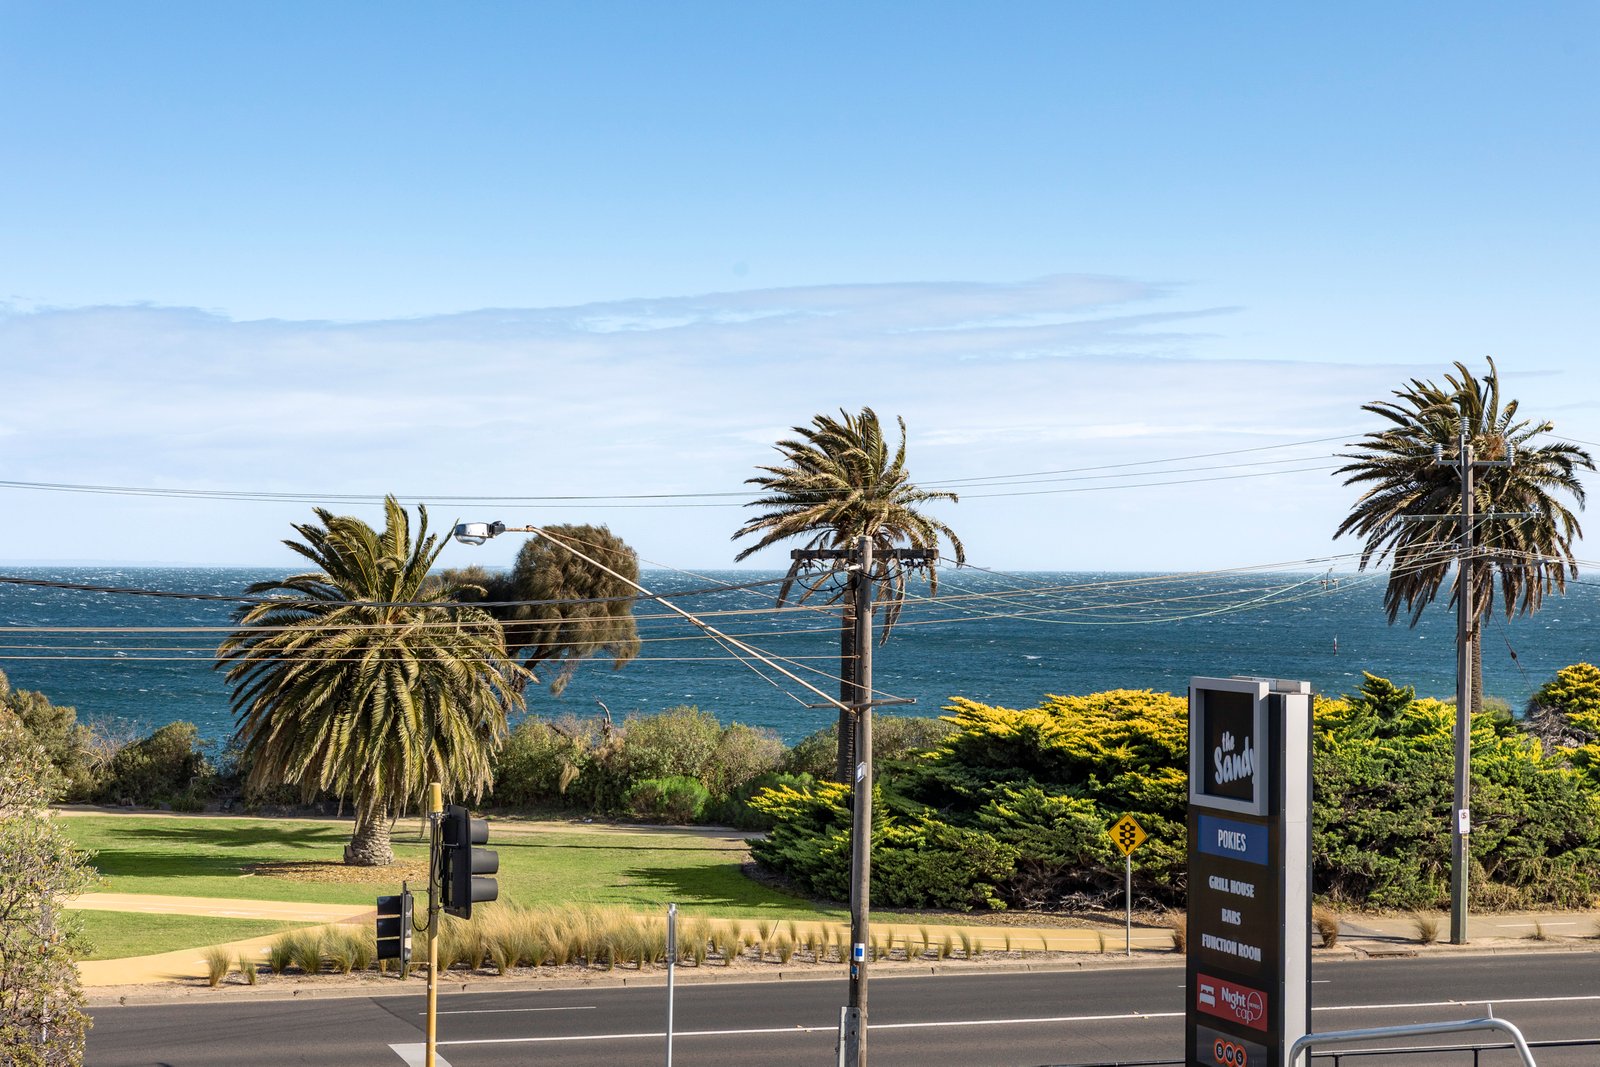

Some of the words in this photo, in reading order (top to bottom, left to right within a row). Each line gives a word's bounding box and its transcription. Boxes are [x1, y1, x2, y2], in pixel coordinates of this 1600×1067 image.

[1222, 731, 1235, 752] the
[1217, 829, 1246, 852] POKIES
[1209, 876, 1229, 893] GRILL
[1230, 880, 1254, 898] HOUSE
[1221, 908, 1241, 925] BARS
[1202, 933, 1237, 955] FUNCTION
[1238, 943, 1261, 961] ROOM
[1221, 987, 1246, 1009] Night
[1235, 1008, 1253, 1024] cap
